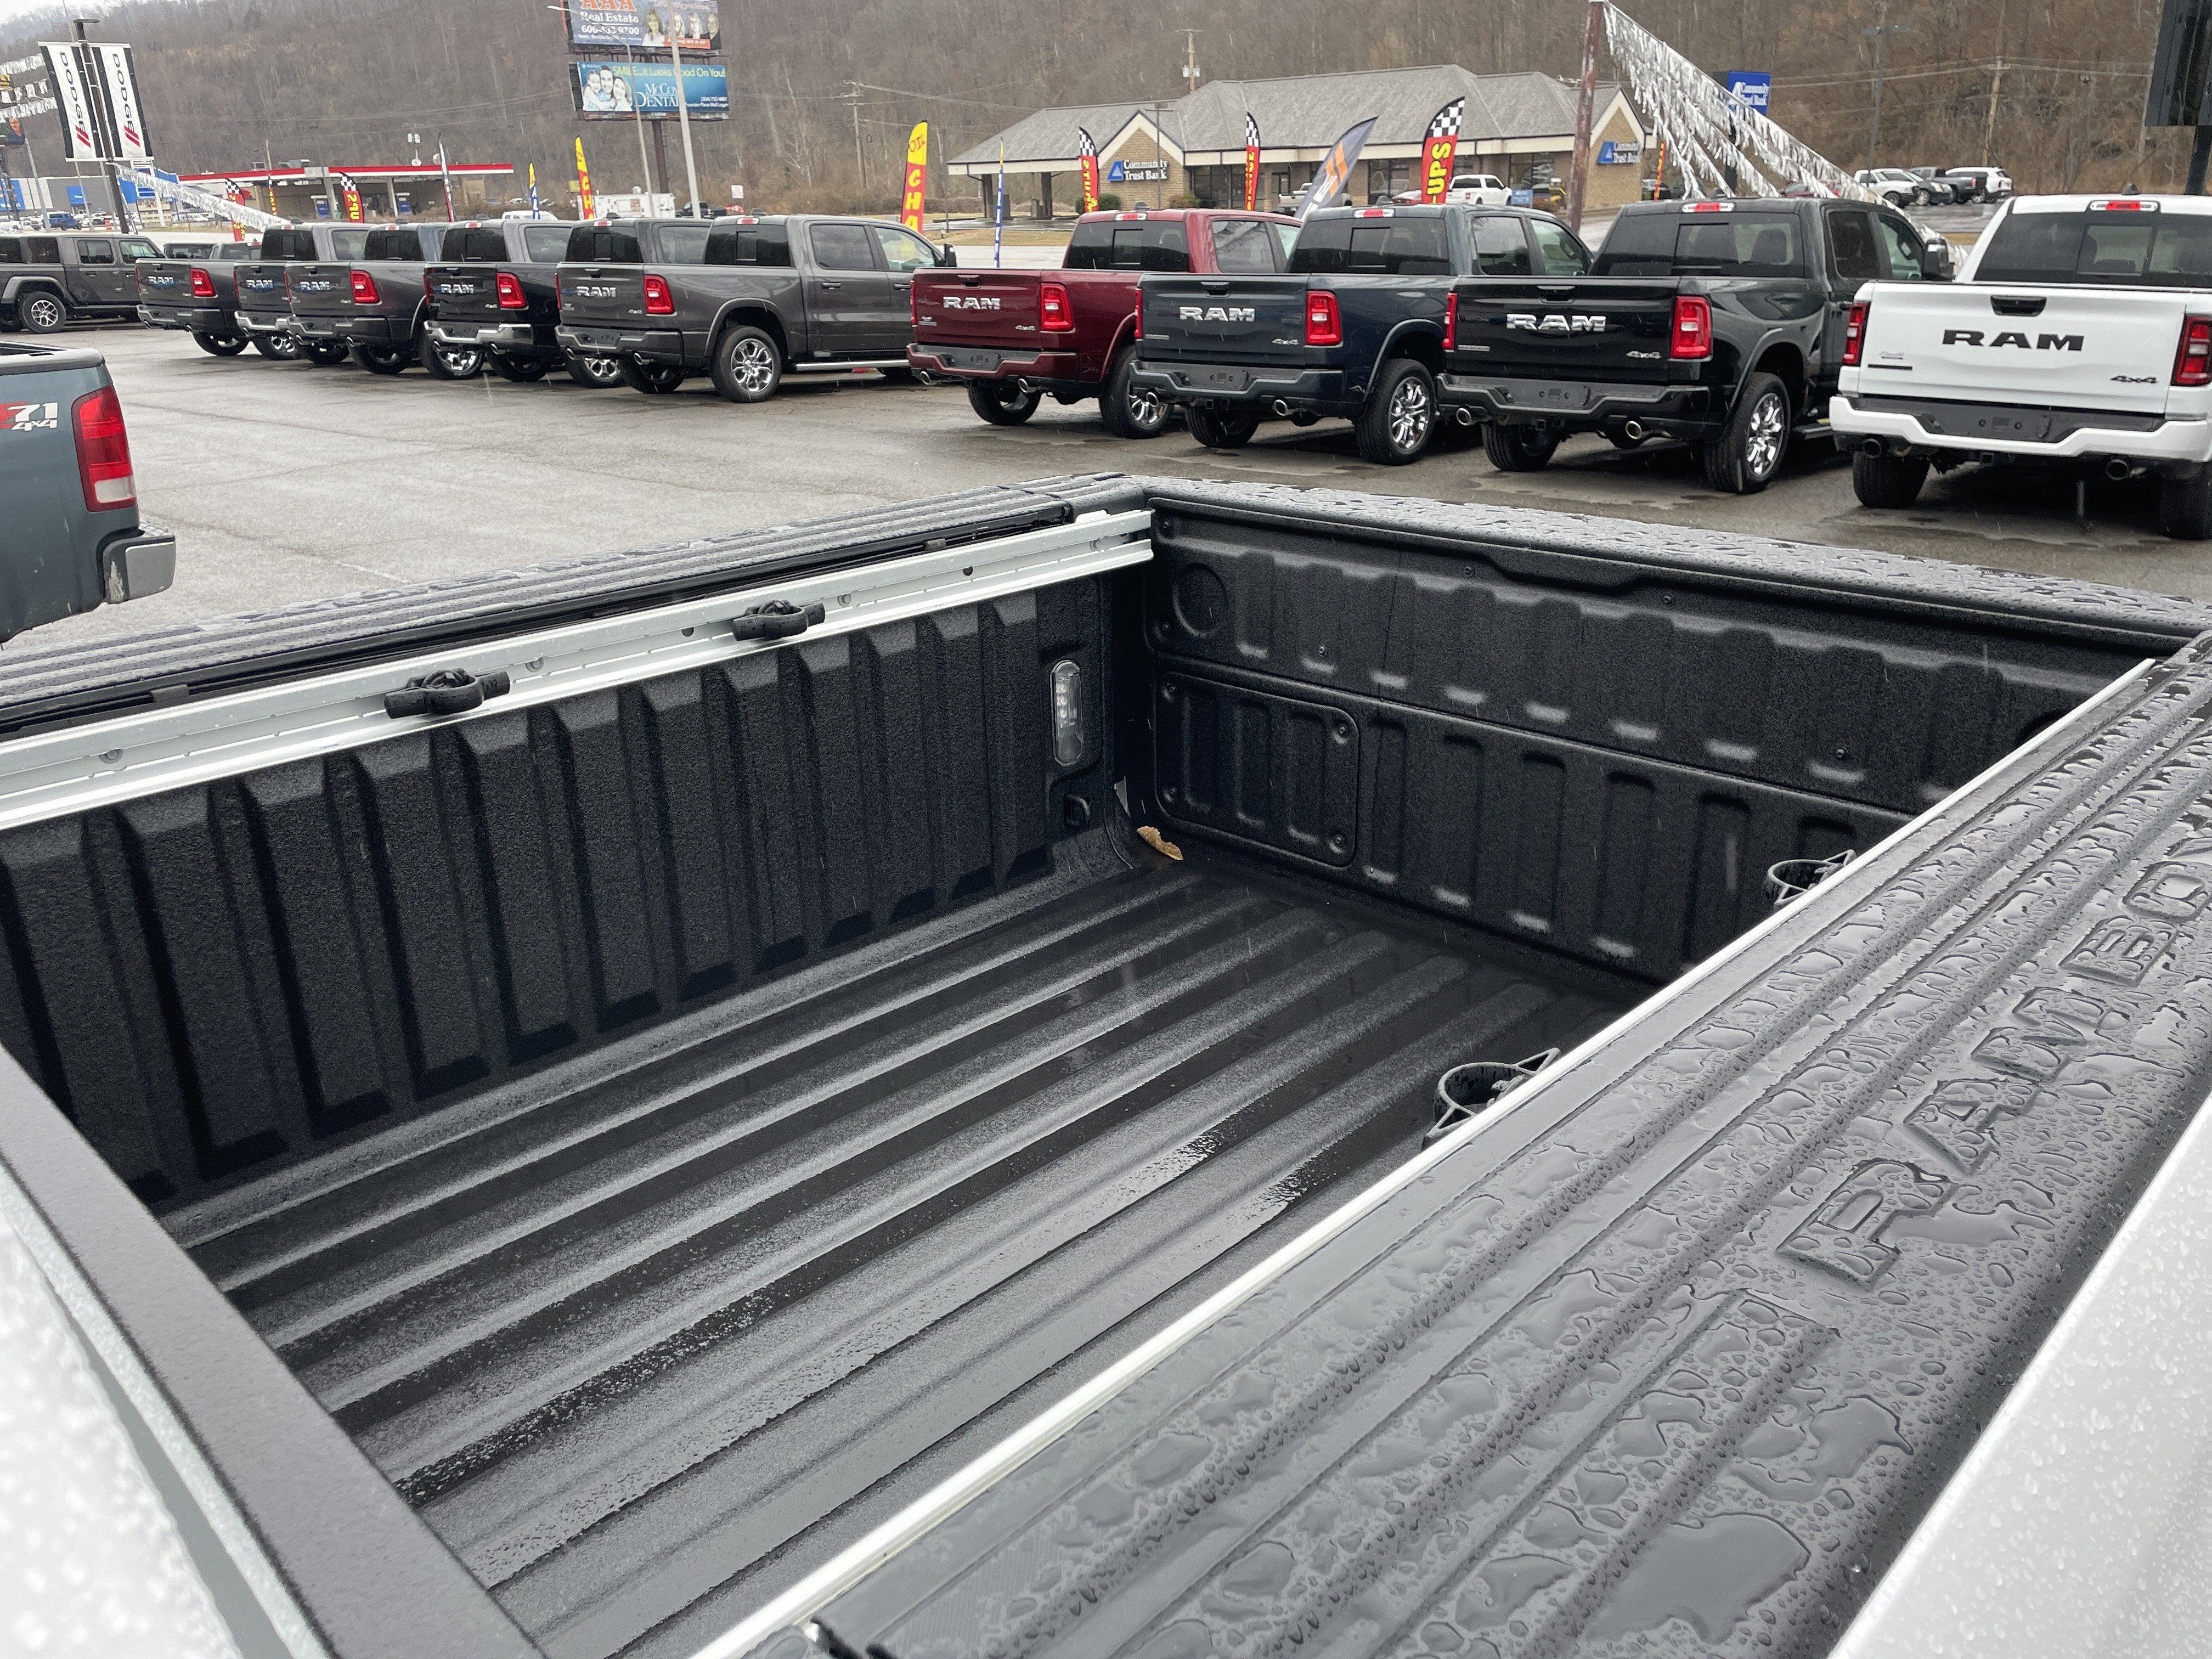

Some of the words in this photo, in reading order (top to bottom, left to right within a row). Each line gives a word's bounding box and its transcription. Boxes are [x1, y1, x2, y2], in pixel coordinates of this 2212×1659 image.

[580, 12, 603, 21] Real
[605, 13, 639, 23] Estate
[650, 67, 672, 76] Looks
[673, 67, 695, 77] ood
[697, 67, 709, 77] On
[60, 52, 86, 133] DODGE
[112, 54, 135, 133] DODGE
[1124, 160, 1168, 170] Communty
[1124, 171, 1144, 180] Trust
[576, 286, 616, 297] RAM
[943, 296, 1001, 310] RAM
[1179, 306, 1255, 322] RAM
[1506, 314, 1607, 332] RAM
[1942, 329, 2085, 352] RAM
[1626, 351, 1662, 359] 4x4
[2111, 375, 2158, 384] 4x4
[12, 419, 58, 431] 4x4
